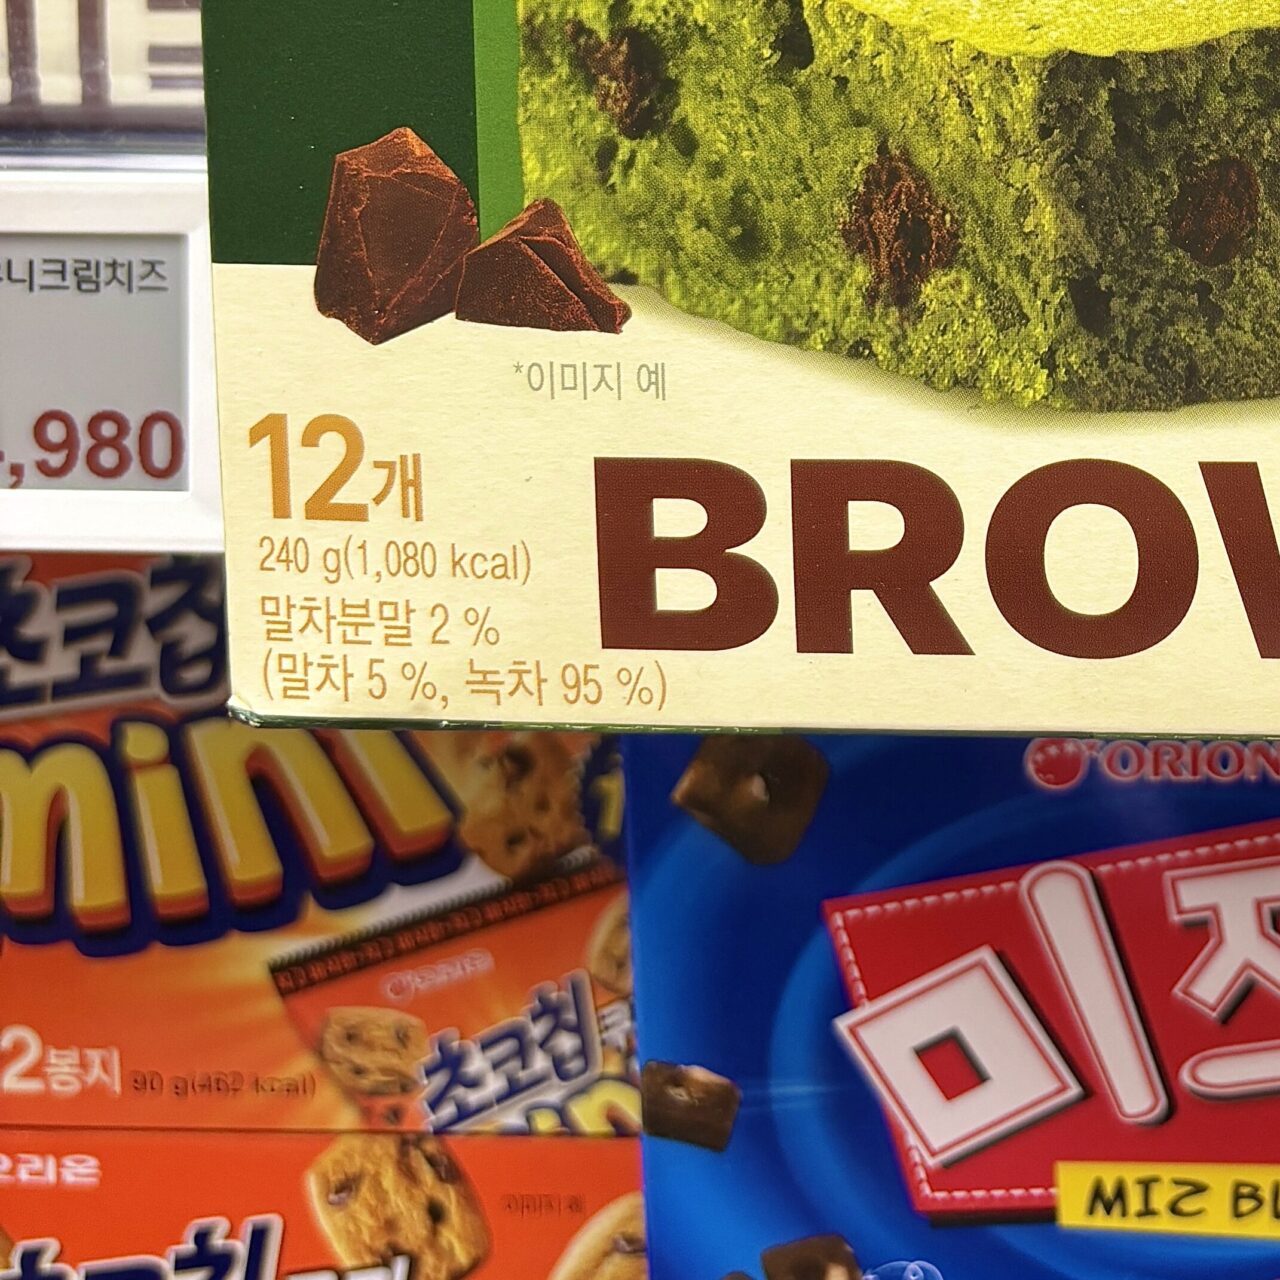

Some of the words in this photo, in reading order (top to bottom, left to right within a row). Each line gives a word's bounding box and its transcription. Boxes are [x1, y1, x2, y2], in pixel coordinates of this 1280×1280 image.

[0, 257, 169, 294] 니크림치즈
[637, 362, 666, 401] 예
[0, 409, 185, 489] ,980
[248, 413, 424, 522] 12개
[259, 535, 309, 573] 240
[323, 534, 437, 584] g(1,080
[451, 540, 532, 586] kcal)
[261, 595, 416, 647] 말차분말
[431, 604, 450, 645] 2
[464, 606, 500, 646] %
[263, 648, 353, 701] (말차
[368, 658, 387, 699] 5
[465, 658, 547, 706] 녹차
[561, 663, 602, 705] 95
[616, 660, 667, 710] %)
